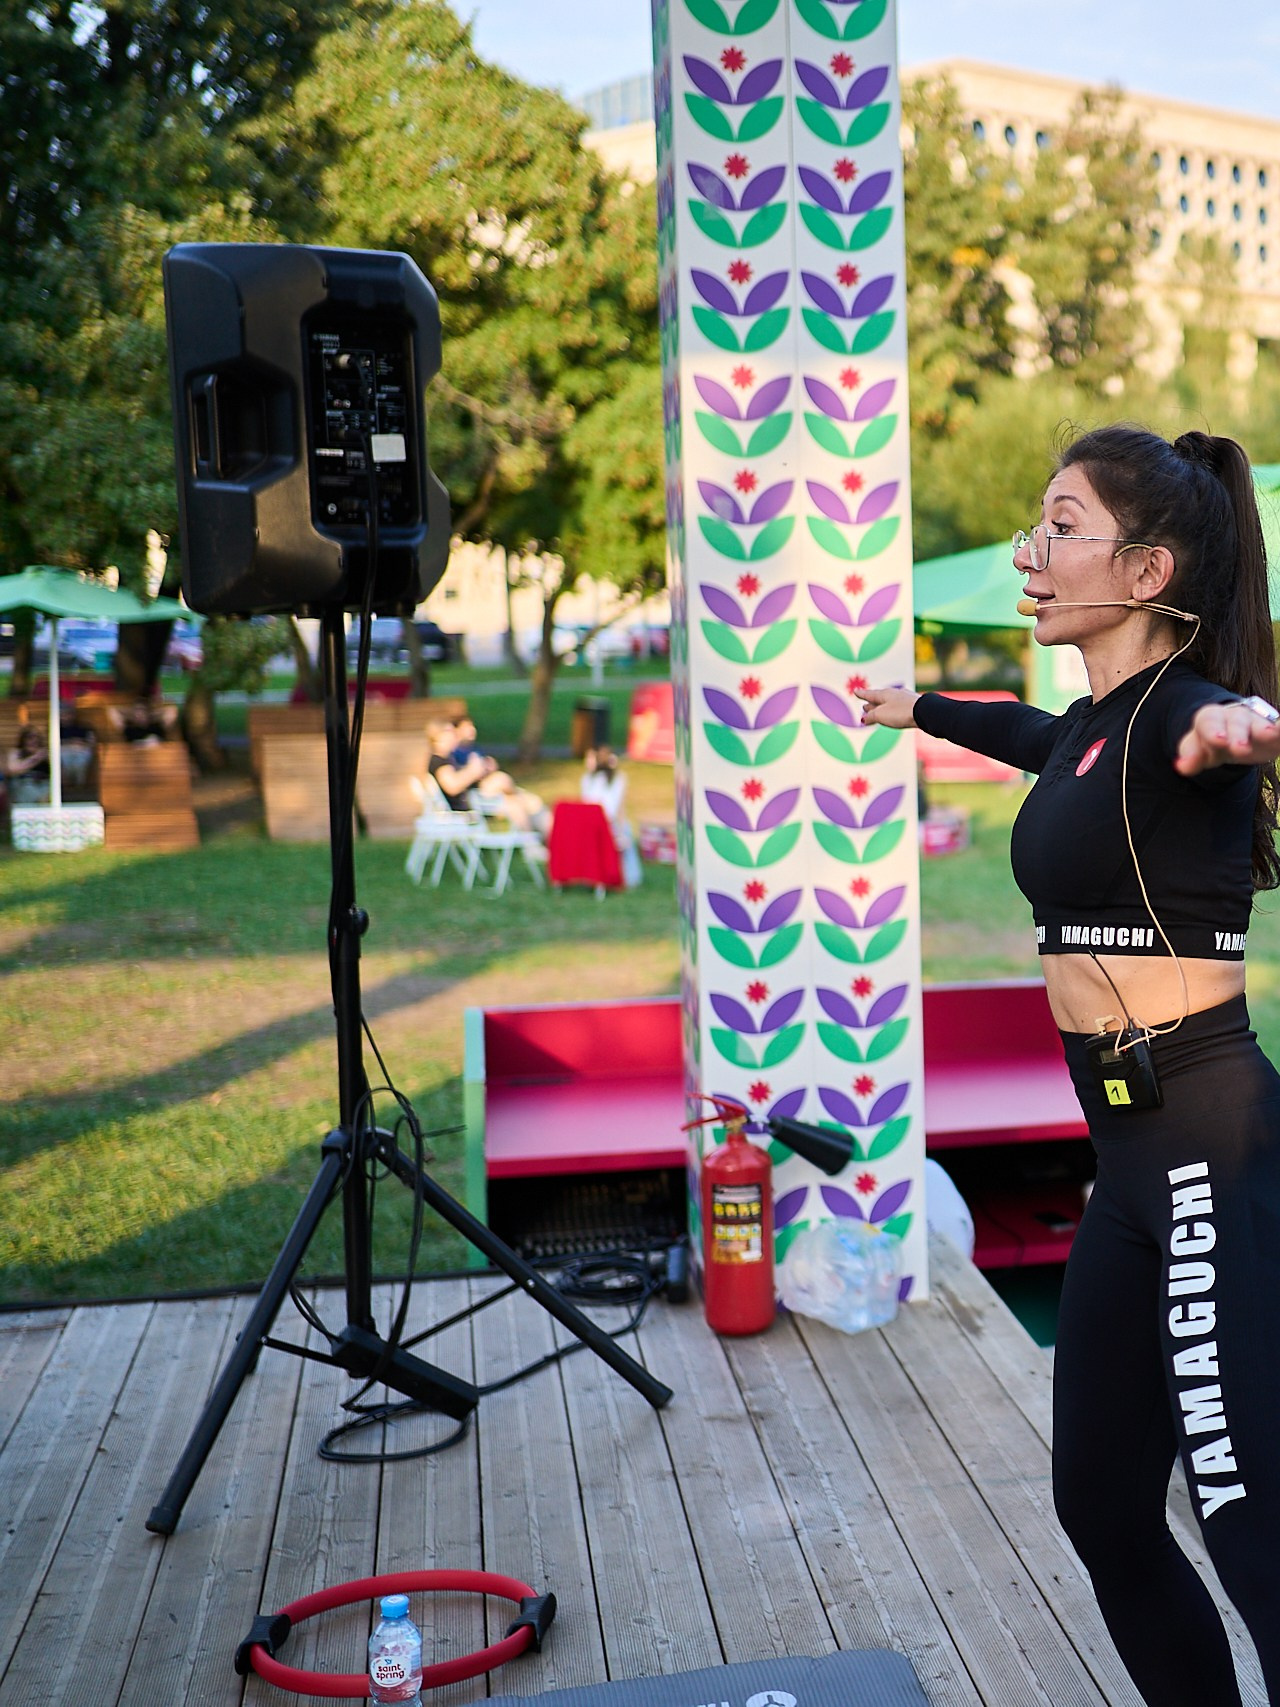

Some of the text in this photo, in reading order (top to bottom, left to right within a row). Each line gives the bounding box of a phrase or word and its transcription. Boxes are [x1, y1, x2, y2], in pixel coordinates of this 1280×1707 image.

[1061, 925, 1155, 948] YAMAGUCHI
[1111, 1085, 1121, 1101] 1
[1167, 1161, 1247, 1520] YAMAGUCHI
[375, 1670, 405, 1681] spring
[378, 1663, 402, 1673] saint
